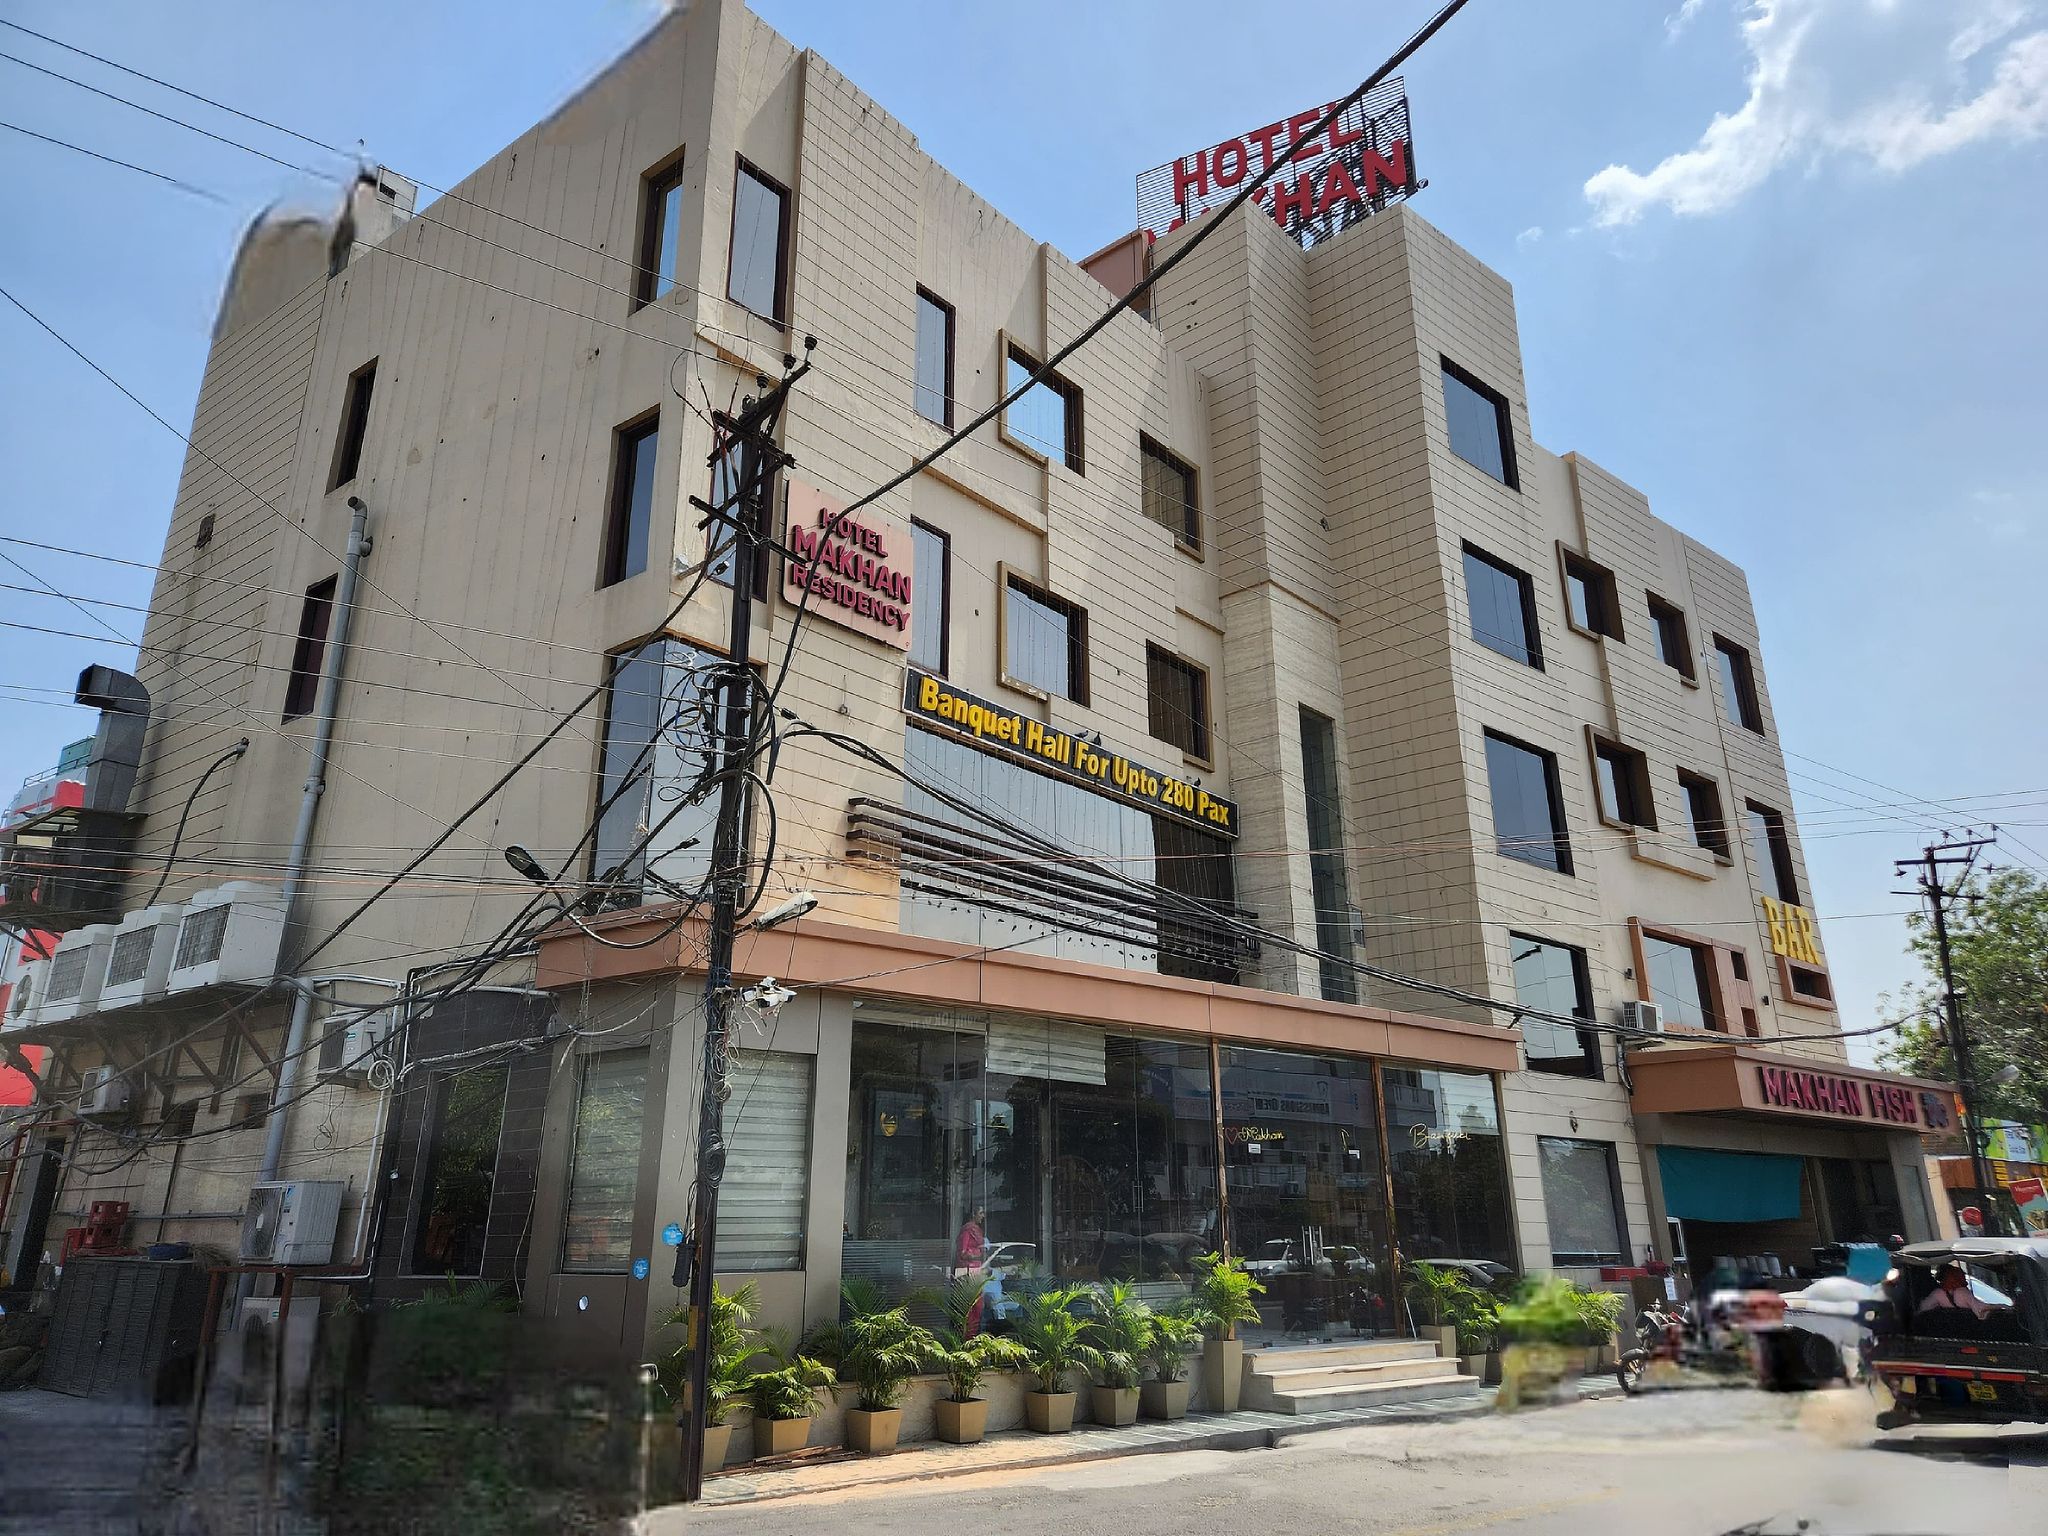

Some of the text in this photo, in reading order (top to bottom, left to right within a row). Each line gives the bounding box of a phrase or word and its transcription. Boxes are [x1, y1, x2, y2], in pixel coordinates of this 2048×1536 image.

[1173, 102, 1362, 205] HOTEL
[793, 524, 912, 605] MAKHAN
[820, 507, 889, 558] HOTEL
[791, 562, 911, 632] RESIDENCY
[919, 675, 1230, 827] Banquet Hall For Upto 280 Pax
[1761, 896, 1822, 966] BAR
[1757, 1066, 1919, 1124] MAKHAN FISH
